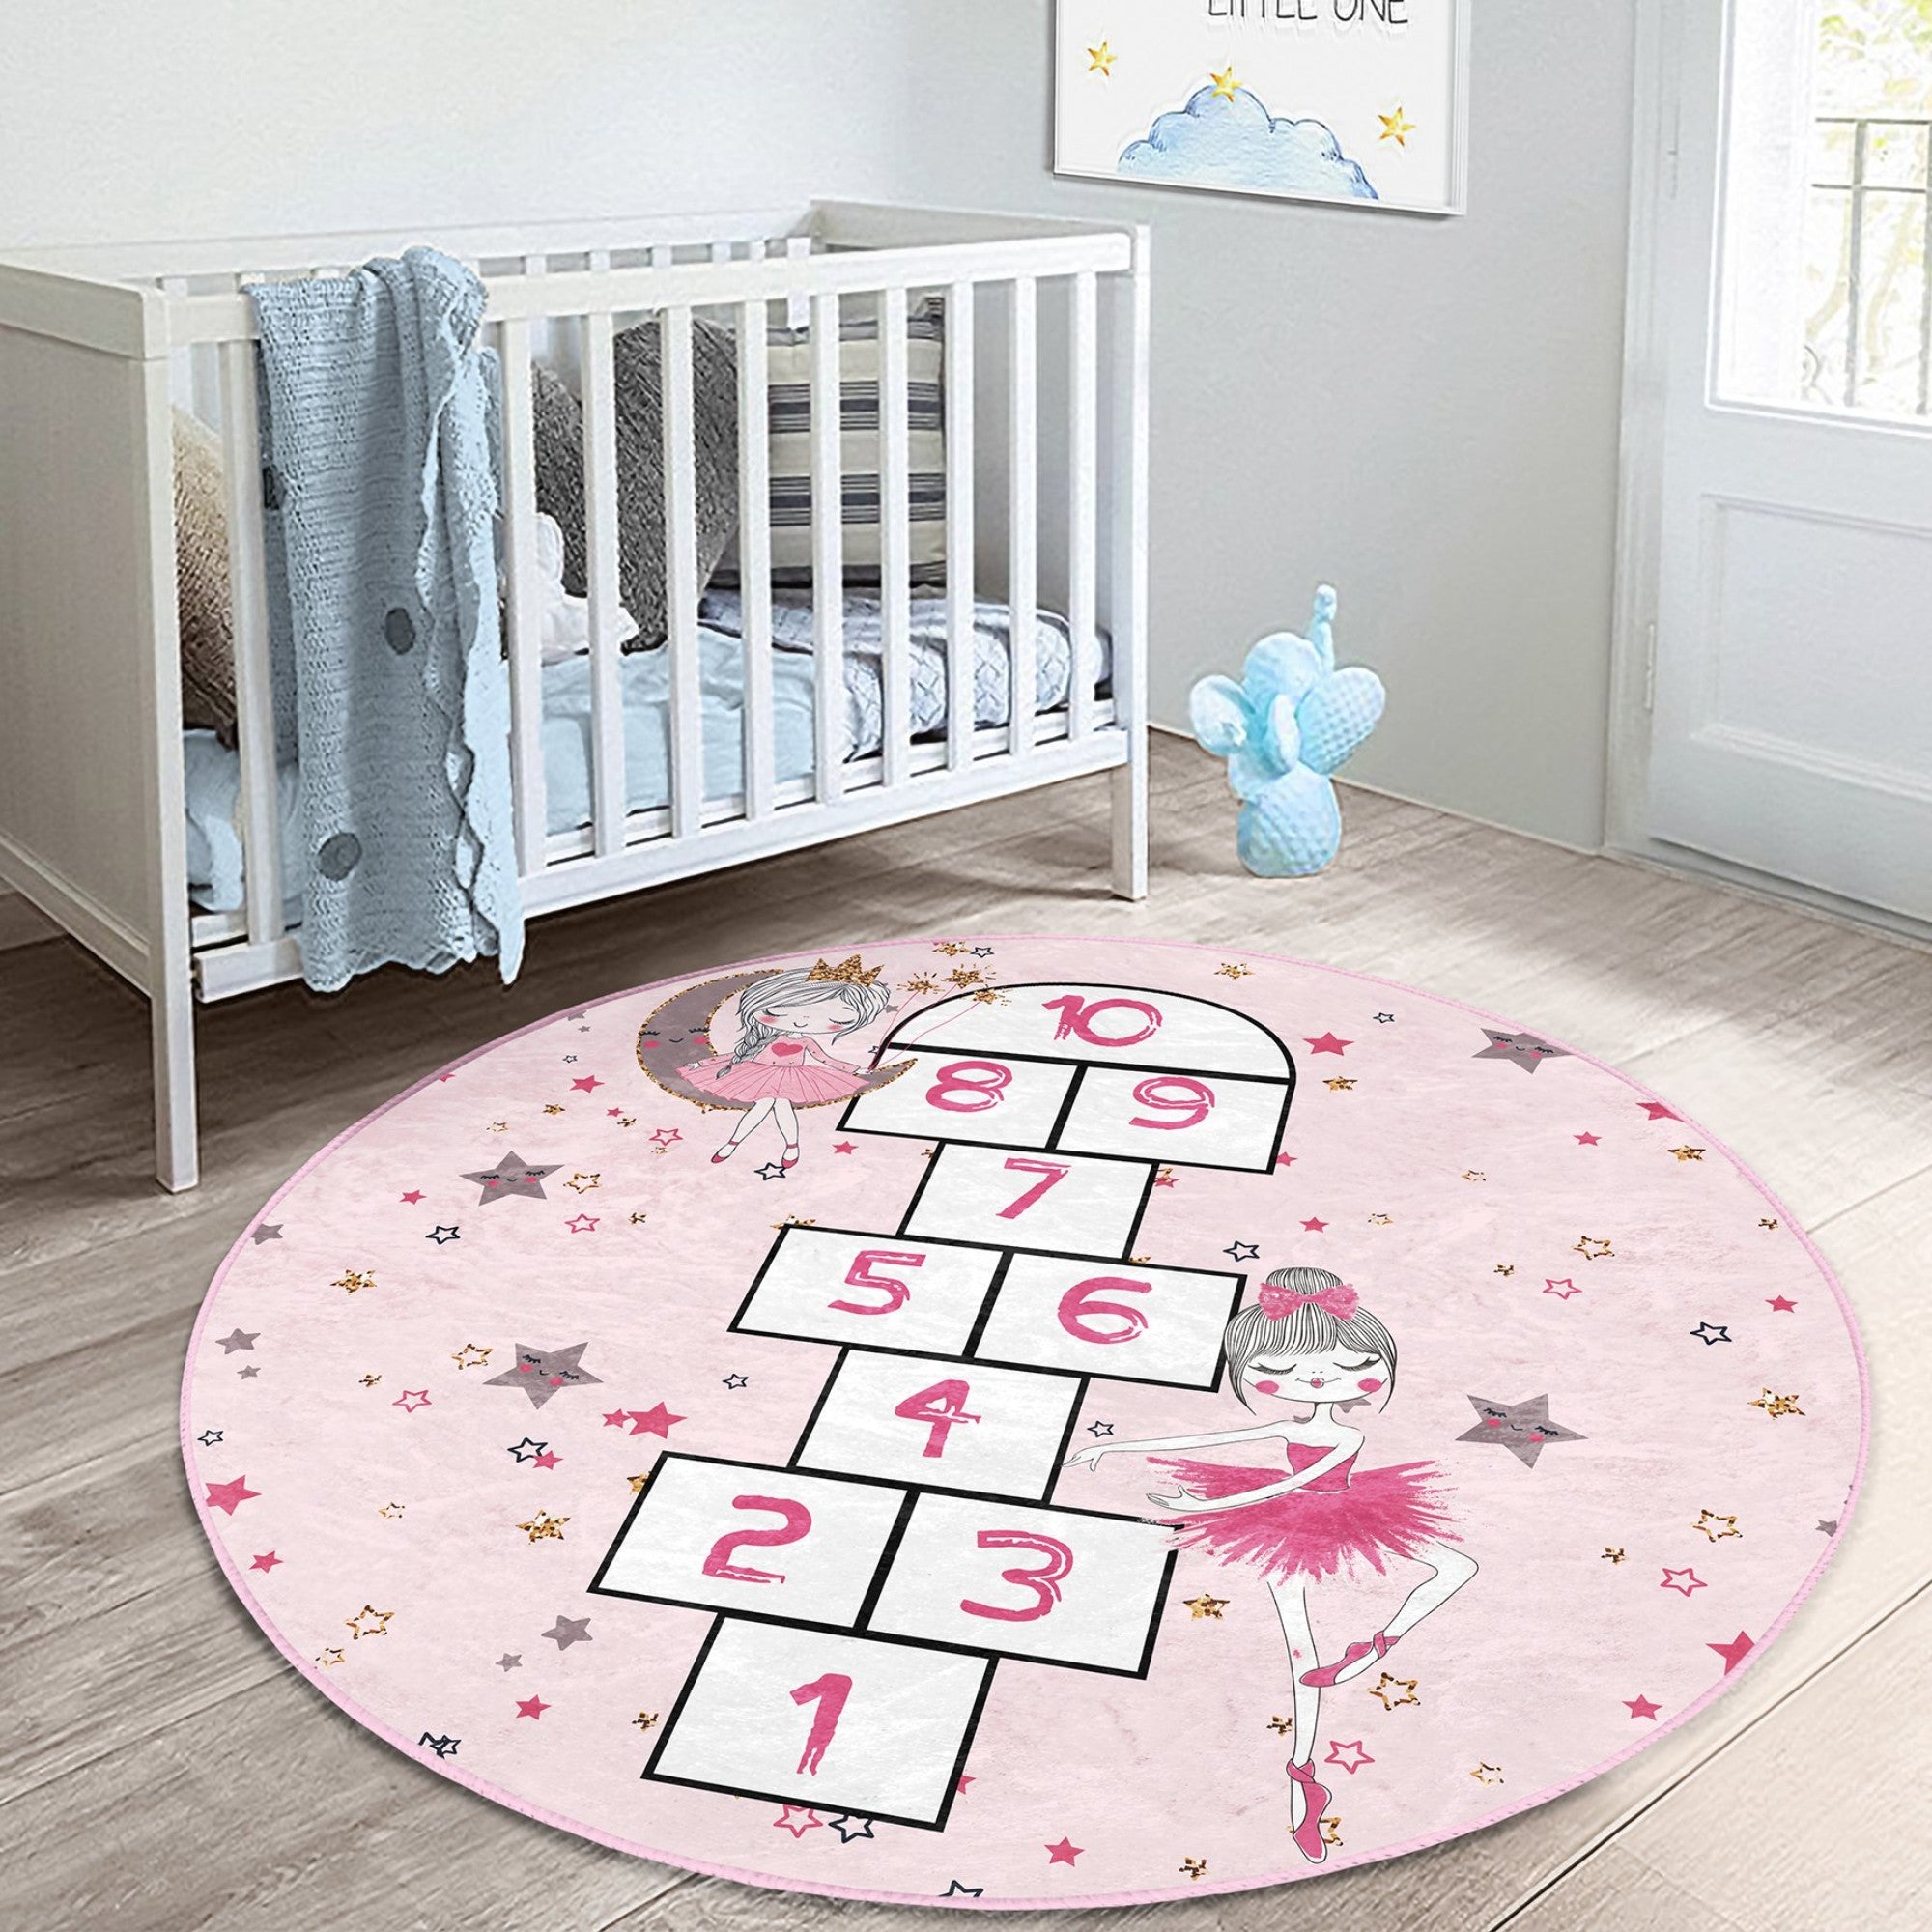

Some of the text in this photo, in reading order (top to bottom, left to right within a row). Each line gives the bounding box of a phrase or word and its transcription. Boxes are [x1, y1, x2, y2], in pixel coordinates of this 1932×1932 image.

[1042, 993, 1163, 1047] 10
[925, 1060, 1013, 1112] 8
[1128, 1076, 1215, 1130] 9
[996, 1157, 1071, 1219] 7
[828, 1250, 926, 1315] 5
[1058, 1276, 1152, 1344] 6
[895, 1378, 981, 1458] 4
[702, 1494, 812, 1584] 2
[959, 1529, 1074, 1622] 3
[789, 1672, 853, 1776] 1
